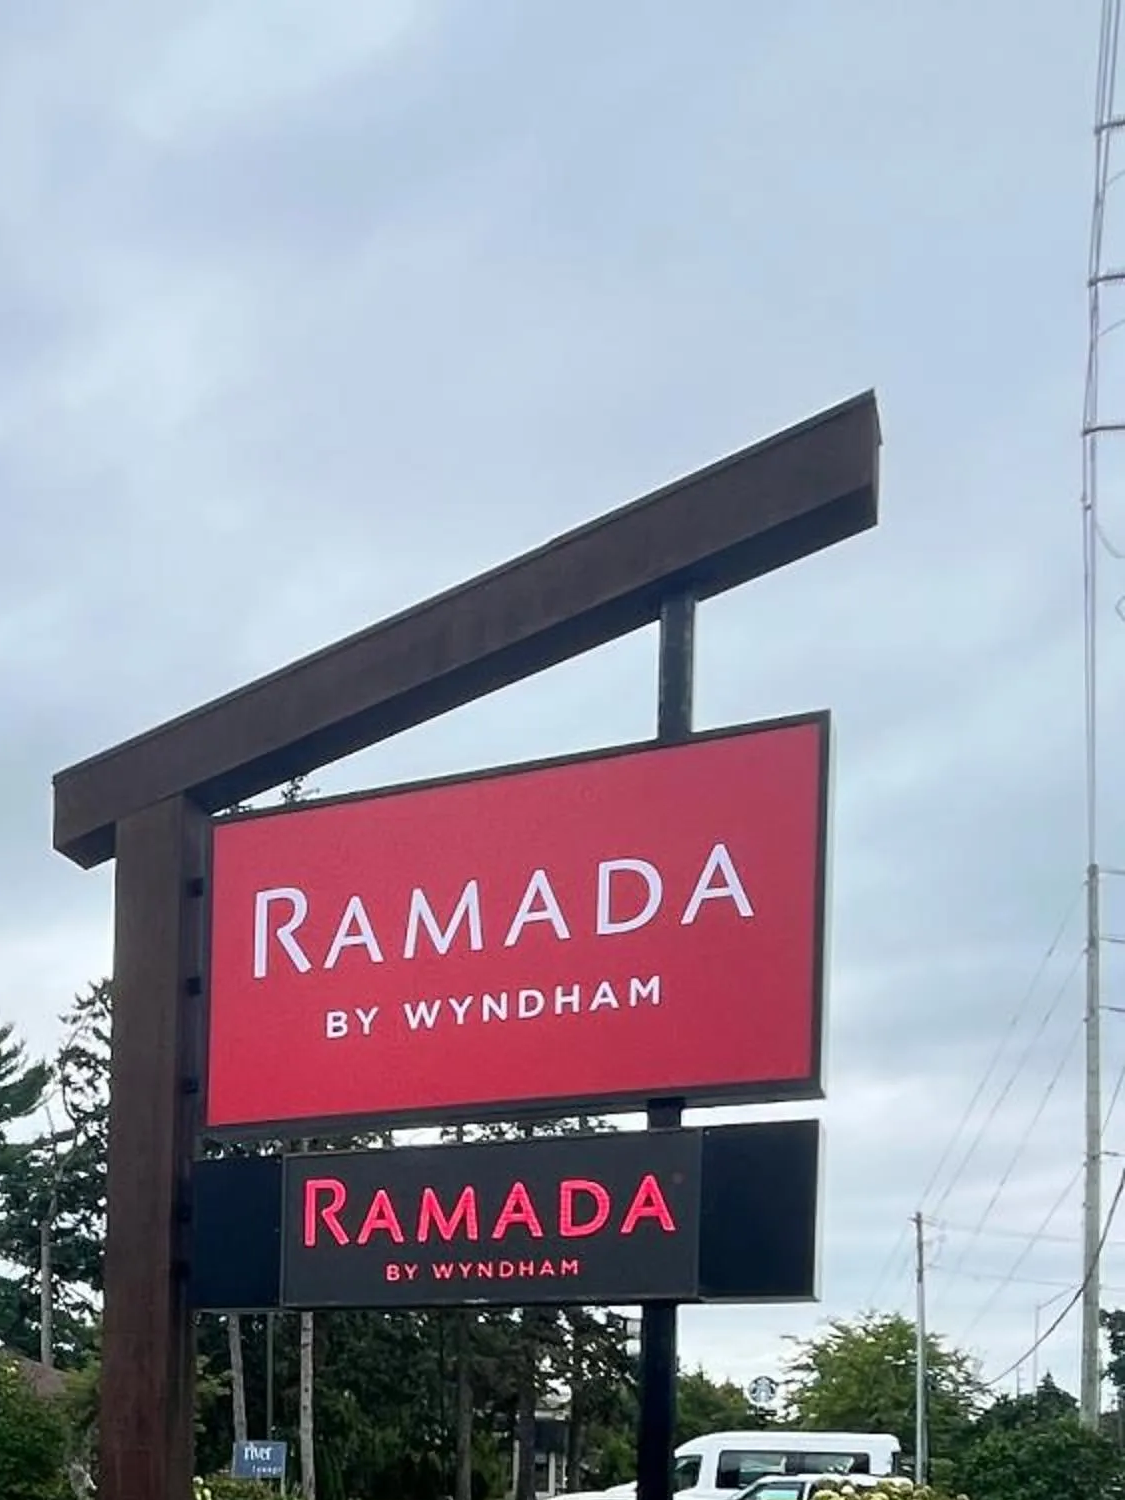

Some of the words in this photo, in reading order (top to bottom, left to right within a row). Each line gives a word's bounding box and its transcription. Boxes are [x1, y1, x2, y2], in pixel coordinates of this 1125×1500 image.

[253, 843, 754, 979] RAMADA
[326, 1007, 379, 1039] BY
[404, 975, 661, 1030] WYNDHAM
[303, 1174, 676, 1247] RAMADA
[386, 1263, 418, 1281] BY
[432, 1258, 579, 1279] WYNDHAM
